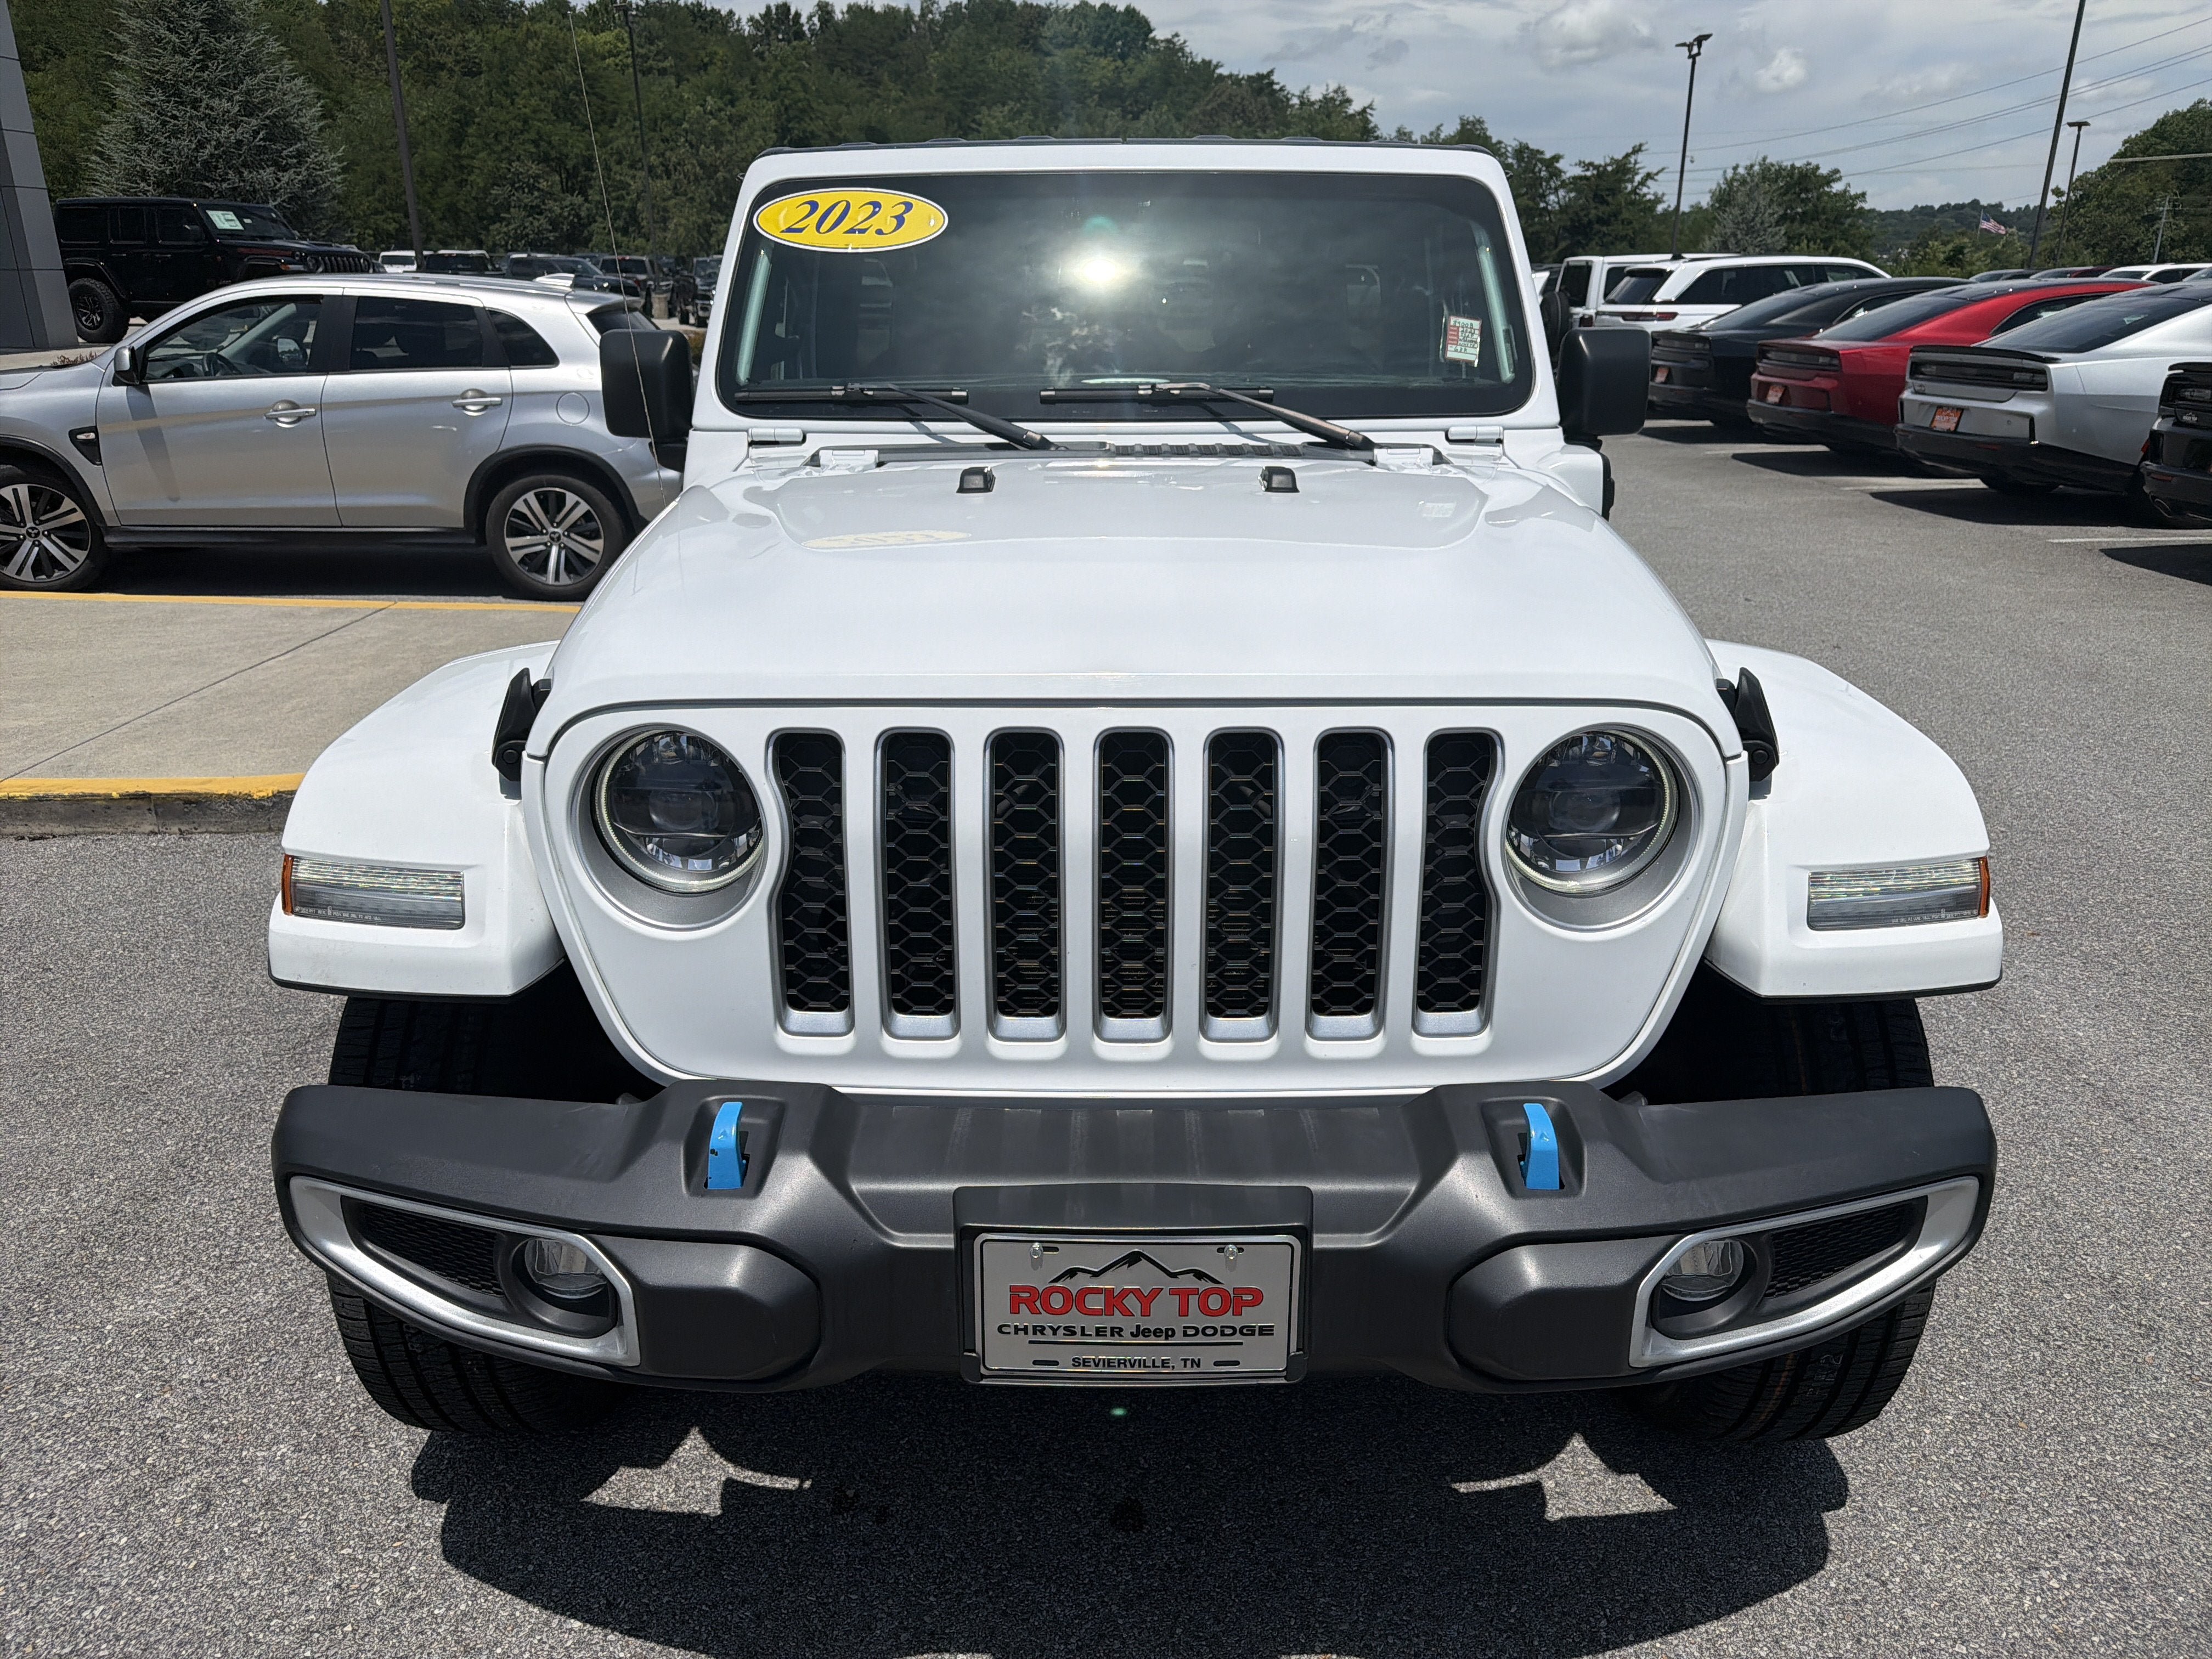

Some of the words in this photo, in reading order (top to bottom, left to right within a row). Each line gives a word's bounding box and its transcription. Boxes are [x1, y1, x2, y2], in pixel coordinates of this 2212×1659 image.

[779, 200, 913, 235] 2023
[1009, 1285, 1164, 1317] ROCKY
[1169, 1286, 1264, 1317] TOP
[997, 1324, 1124, 1338] CHRYSLER
[1130, 1324, 1176, 1340] Jeep
[1182, 1324, 1275, 1338] DODGE
[1071, 1357, 1175, 1370] SEVIERVILLE,
[1181, 1358, 1201, 1369] TN
